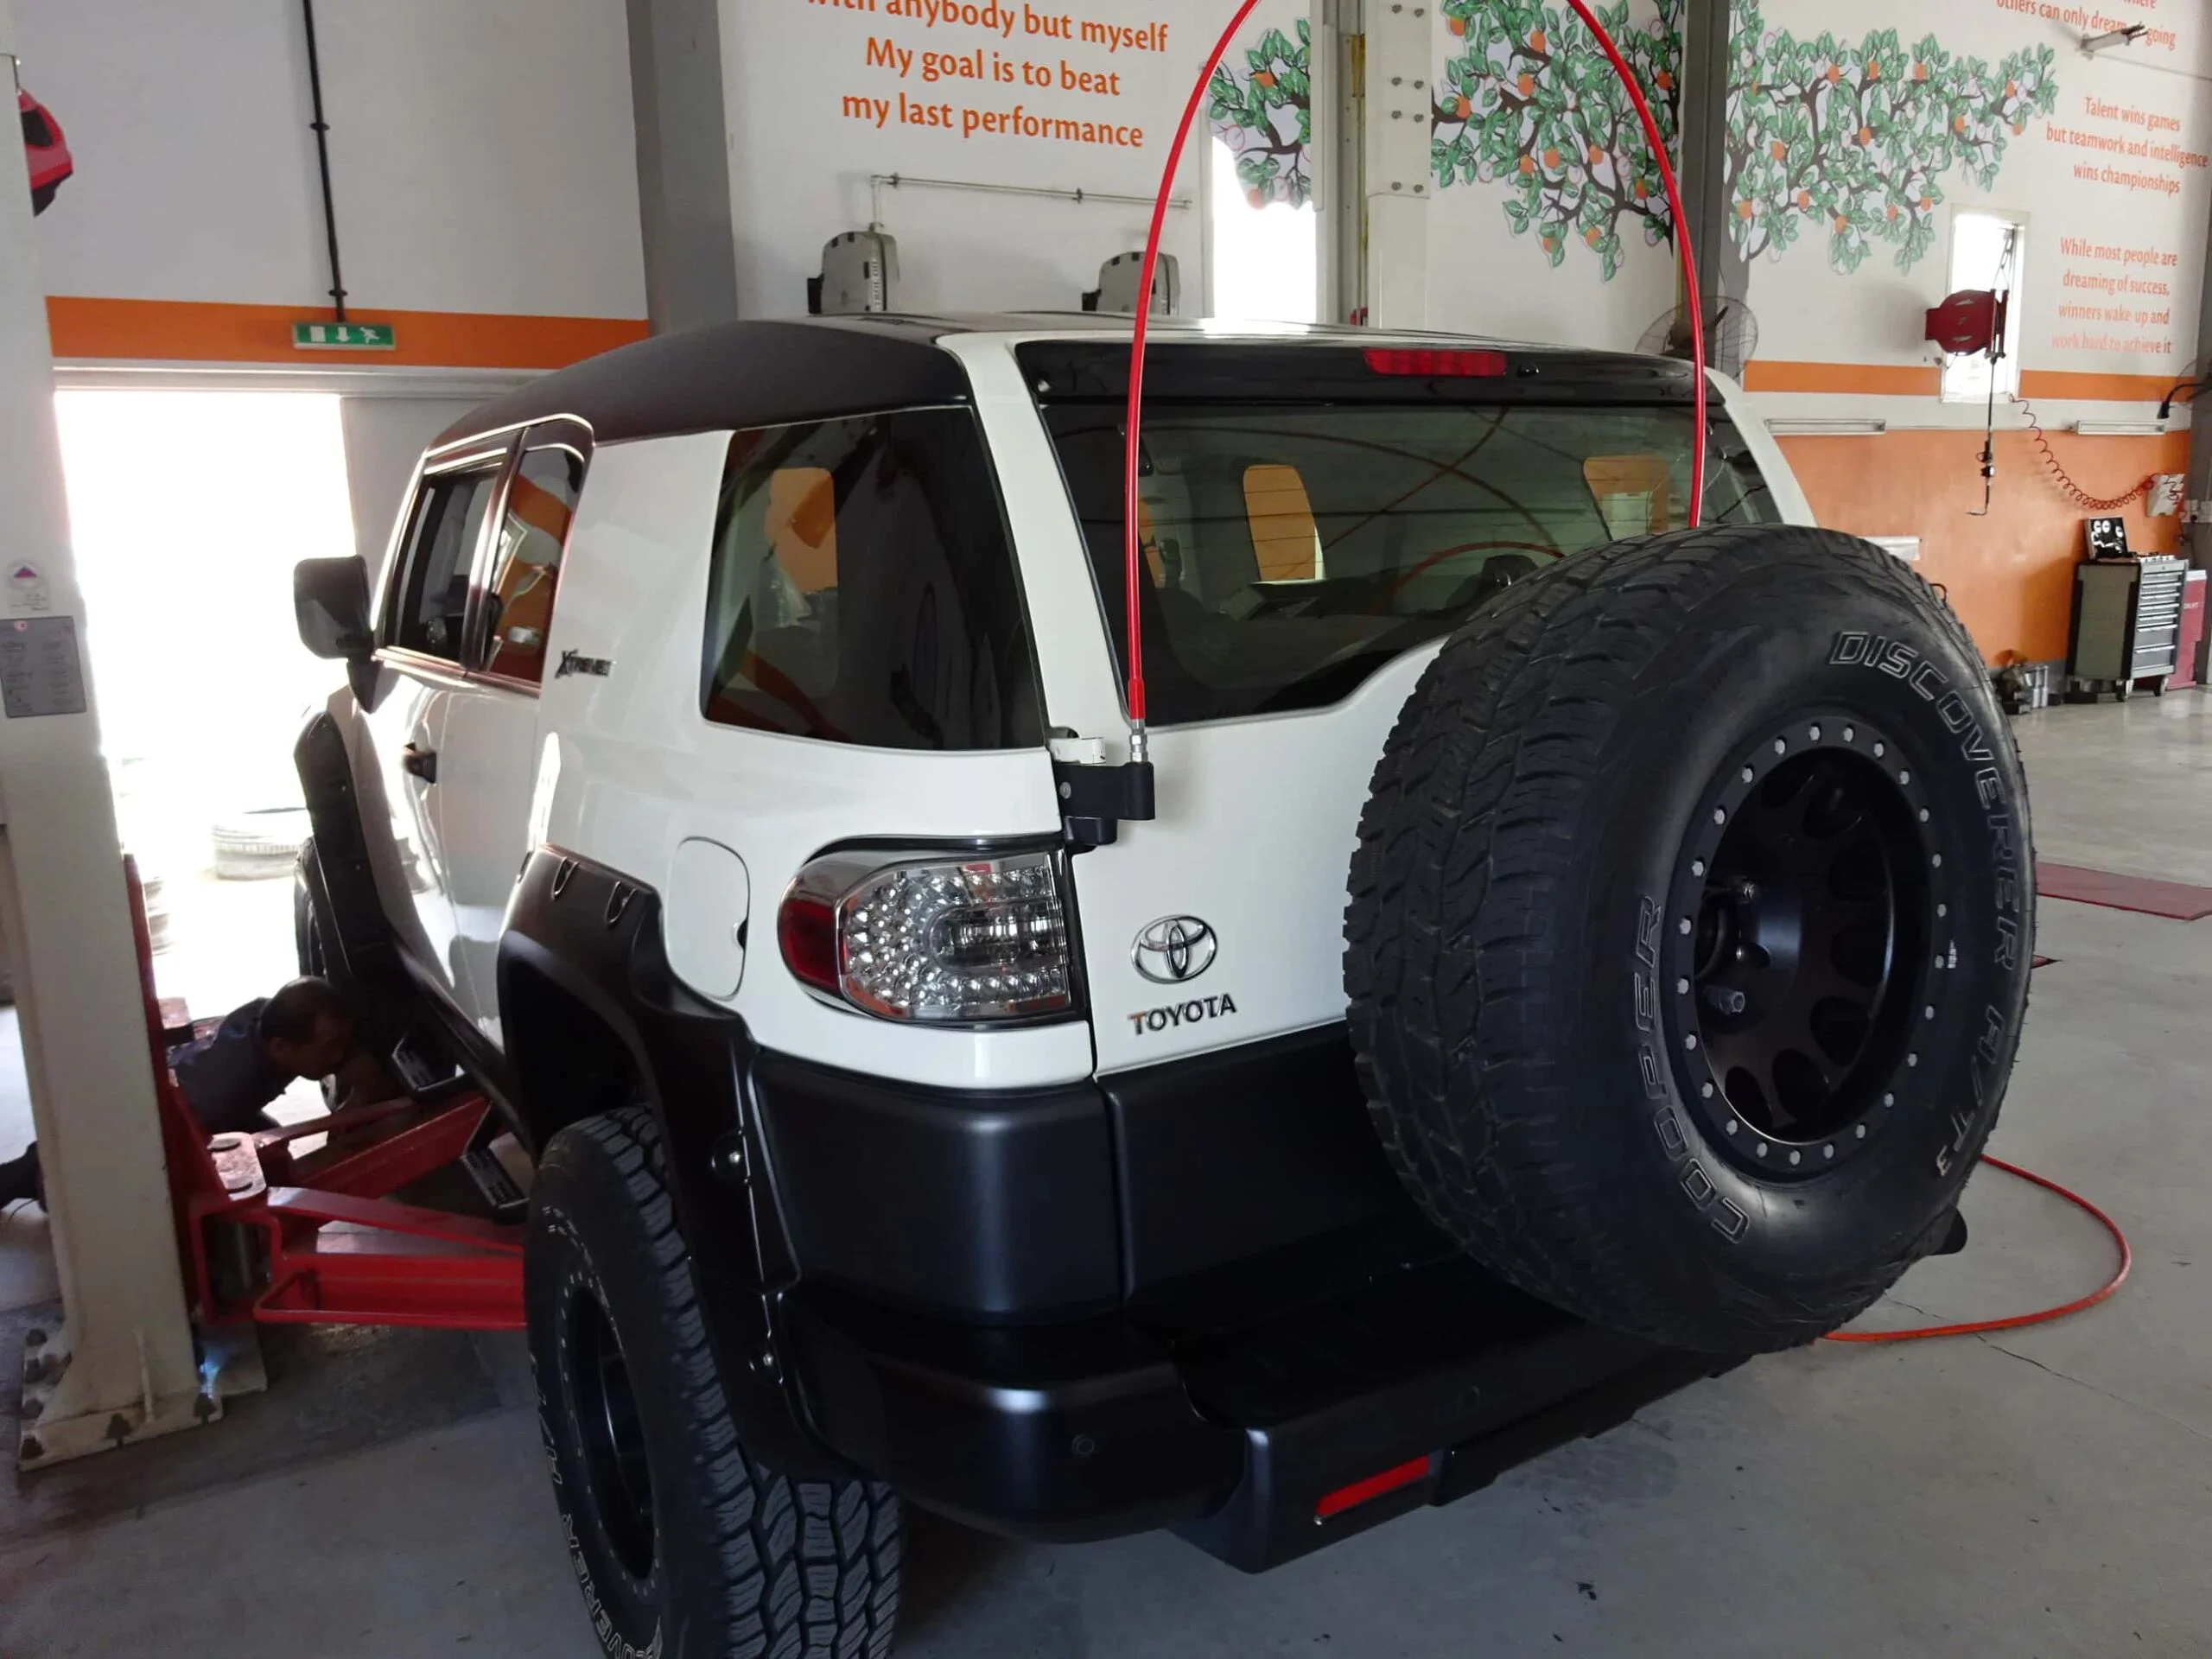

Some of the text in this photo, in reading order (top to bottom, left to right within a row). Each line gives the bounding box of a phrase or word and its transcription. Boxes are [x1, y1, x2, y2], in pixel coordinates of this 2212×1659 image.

[886, 0, 1169, 53] anybody but myself
[2039, 3, 2060, 21] can
[2063, 7, 2089, 33] only
[2145, 26, 2177, 50] going
[866, 36, 1121, 96] My goal is to beat
[842, 92, 1143, 148] my last performance
[2085, 96, 2181, 132] Talent wins games
[2046, 122, 2209, 168] but teamwork and intelligence
[2074, 162, 2181, 197] wins championships
[2060, 237, 2177, 269] While most people are
[2063, 269, 2170, 296] dreaming of success,
[2058, 301, 2171, 327] winners wake up and
[2051, 331, 2171, 353] work hard to achieve it
[1828, 632, 2020, 971] DISCOVERER
[1127, 993, 1238, 1037] TOYOTA
[1634, 895, 1750, 1245] COOPER
